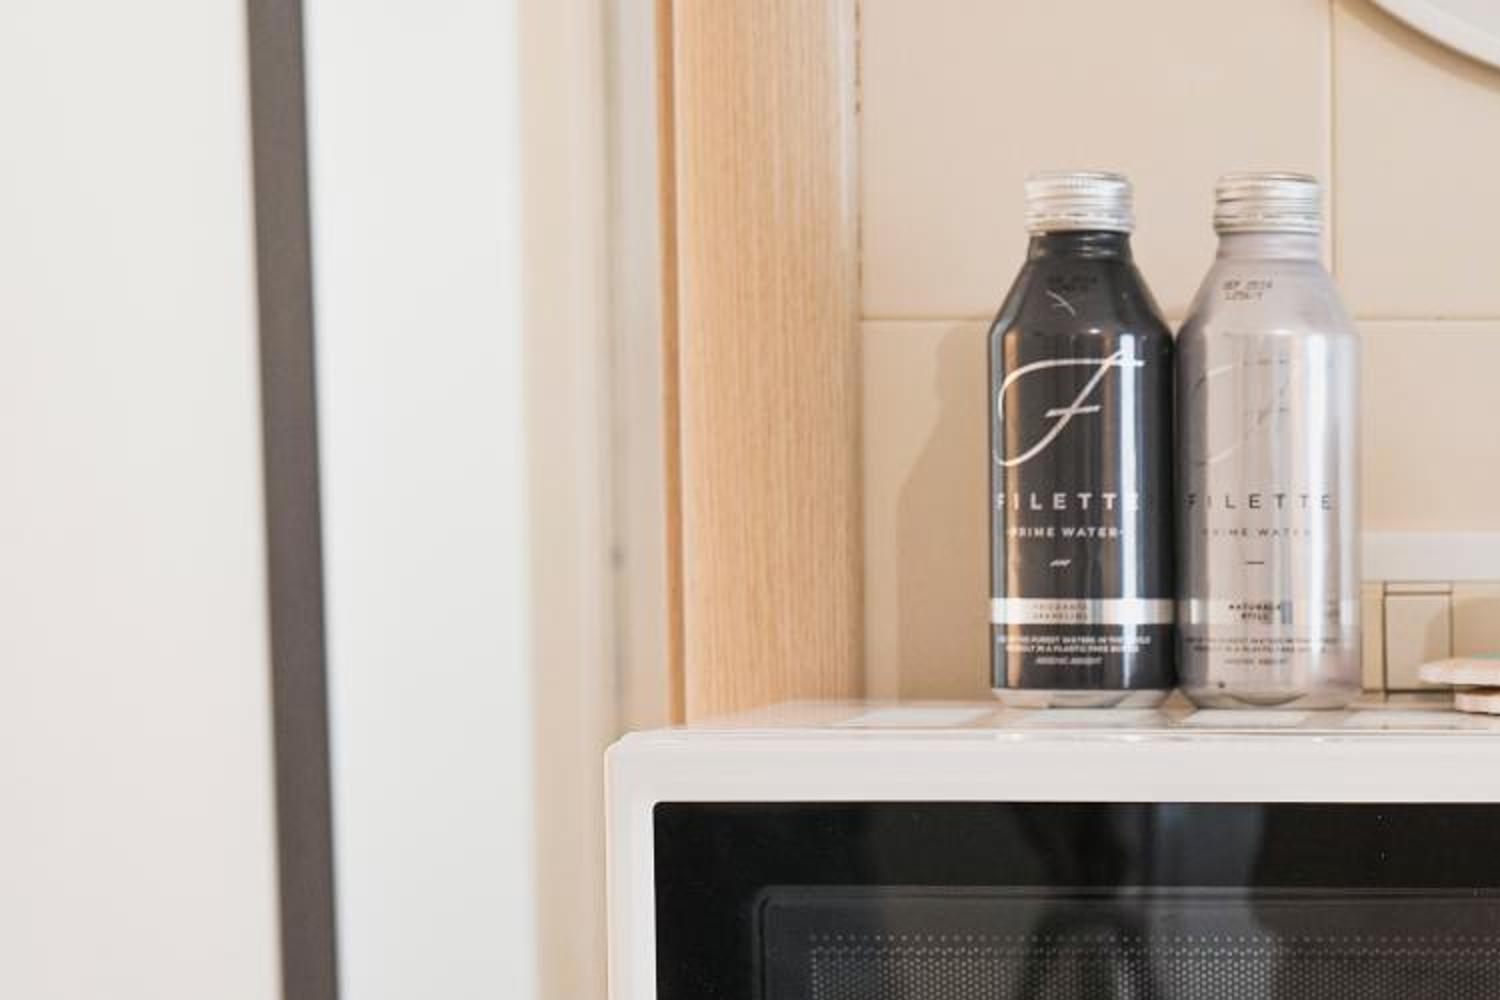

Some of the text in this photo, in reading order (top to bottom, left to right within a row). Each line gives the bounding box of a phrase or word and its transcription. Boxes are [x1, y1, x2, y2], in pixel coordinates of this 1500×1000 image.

[994, 492, 1139, 510] FILETTE
[1186, 493, 1331, 510] FILETTE
[1061, 527, 1117, 538] WATER
